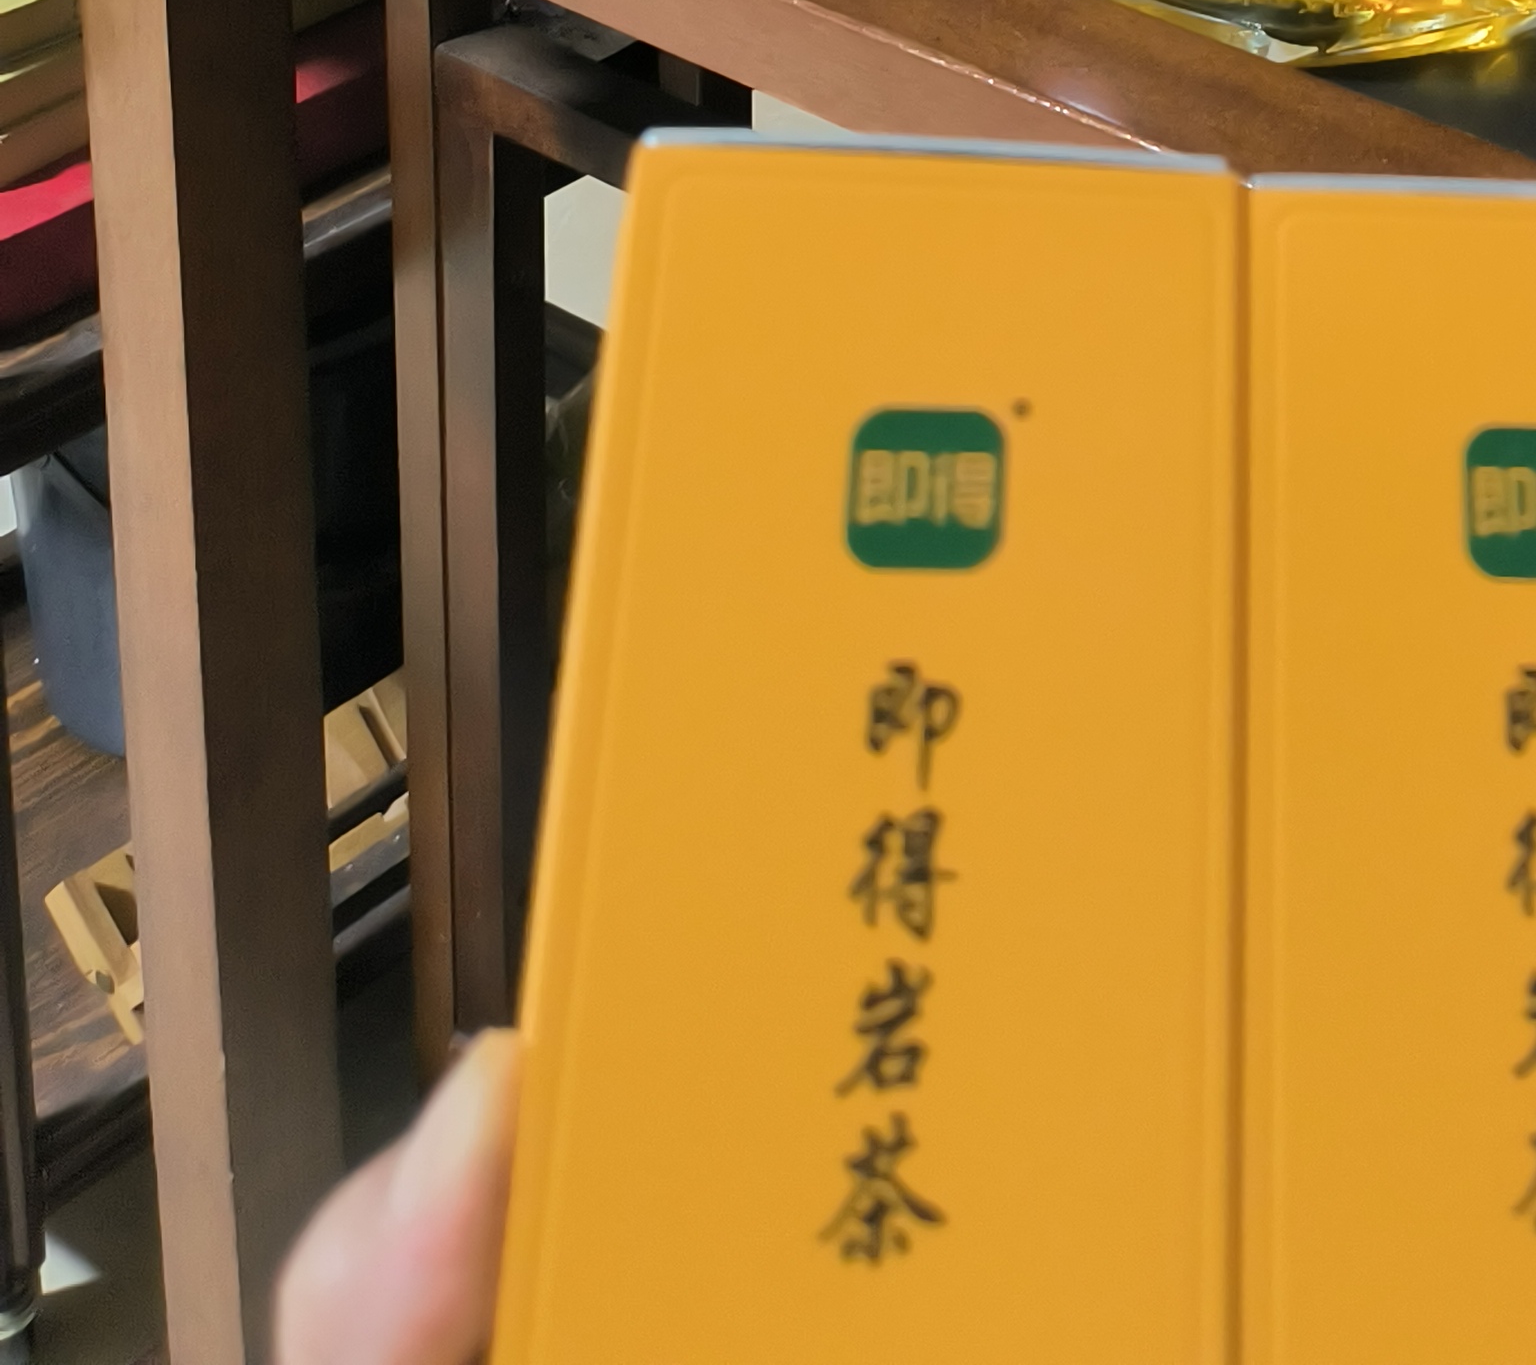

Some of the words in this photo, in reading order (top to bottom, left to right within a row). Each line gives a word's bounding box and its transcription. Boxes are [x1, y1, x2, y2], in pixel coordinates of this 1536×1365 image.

[856, 449, 999, 531] 即得
[815, 660, 962, 1270] 即得岩茶
